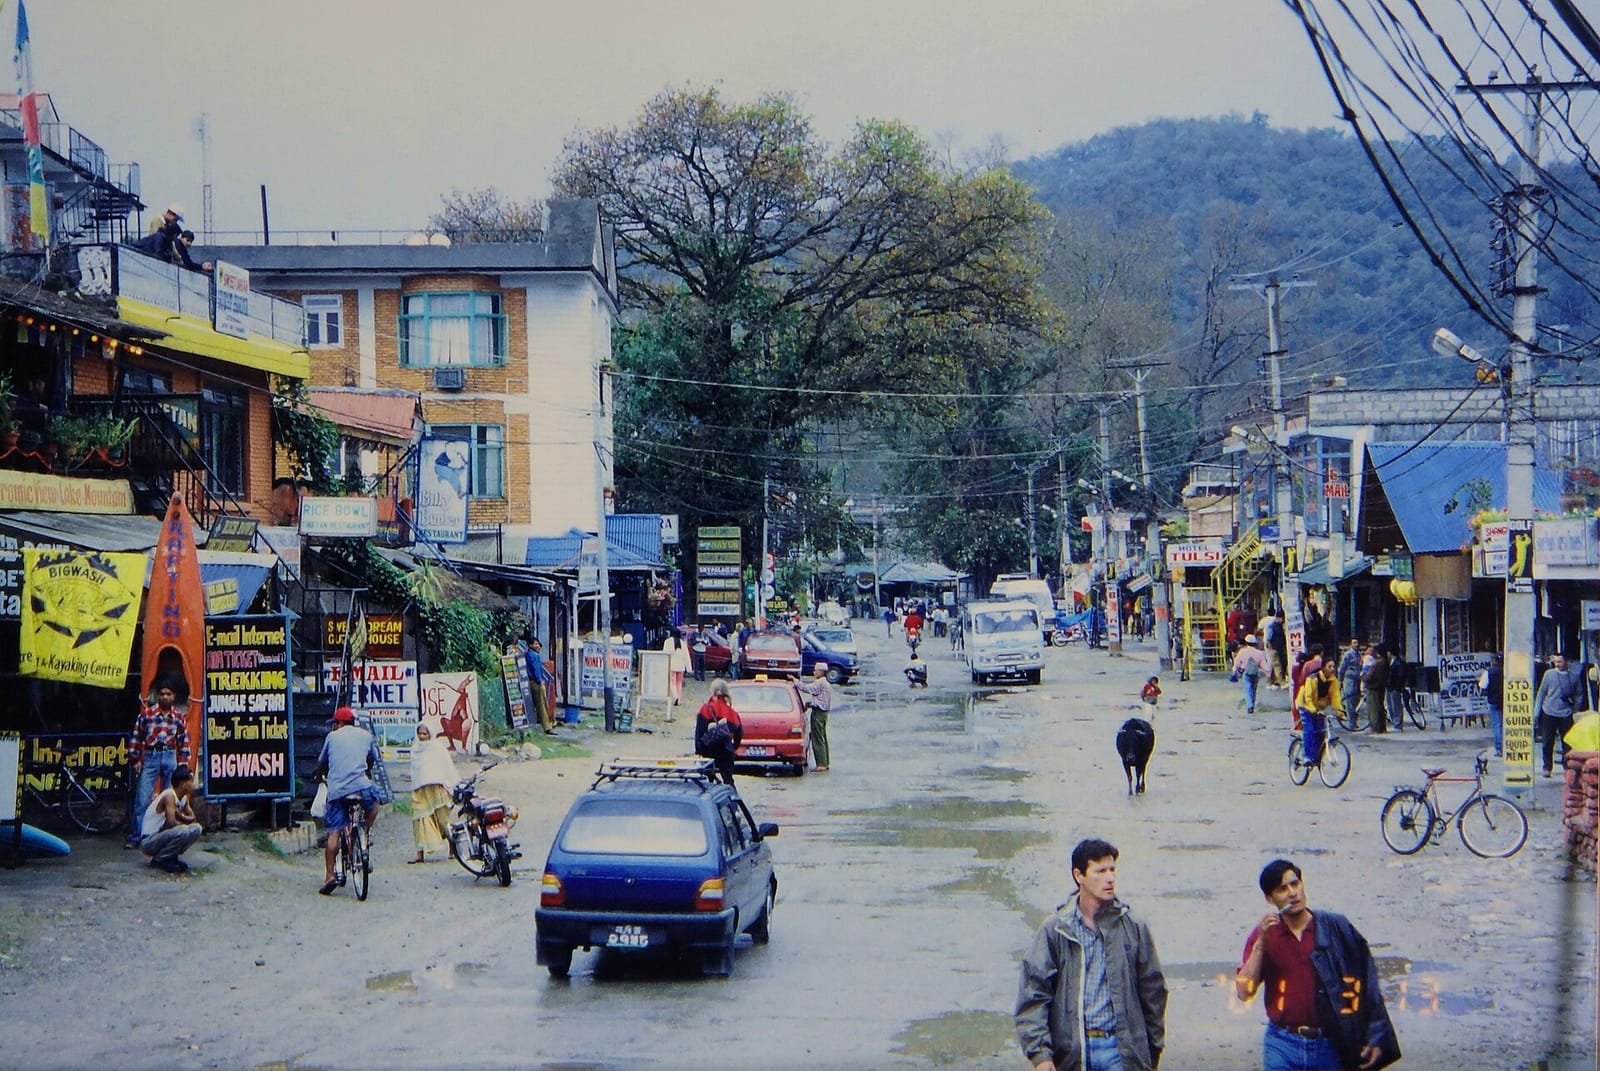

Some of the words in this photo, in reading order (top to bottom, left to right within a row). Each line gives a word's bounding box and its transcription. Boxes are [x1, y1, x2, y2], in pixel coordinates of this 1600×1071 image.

[60, 483, 81, 506] Lake
[1325, 483, 1349, 497] MAIL
[303, 503, 329, 516] RICE
[335, 504, 368, 517] BOWL
[1510, 520, 1534, 530] GOLF
[1172, 551, 1221, 562] TULSI
[48, 566, 107, 586] BIGWASH
[241, 624, 286, 646] Internet
[48, 653, 88, 678] Kayaking
[90, 660, 123, 677] Centre
[223, 649, 258, 669] TICKET
[1453, 654, 1475, 662] CLUB
[1440, 657, 1492, 683] AMSTERDAM
[207, 670, 287, 692] TREKKING
[1449, 682, 1485, 699] OPEN
[207, 694, 246, 714] JUNGLE
[248, 693, 286, 713] SAFARI
[231, 716, 259, 740] Train
[259, 716, 288, 740] Ticket
[1505, 716, 1532, 726] GUIDE
[33, 737, 129, 768] Internet
[1506, 752, 1531, 761] MENT
[211, 752, 284, 778] BIGWASH
